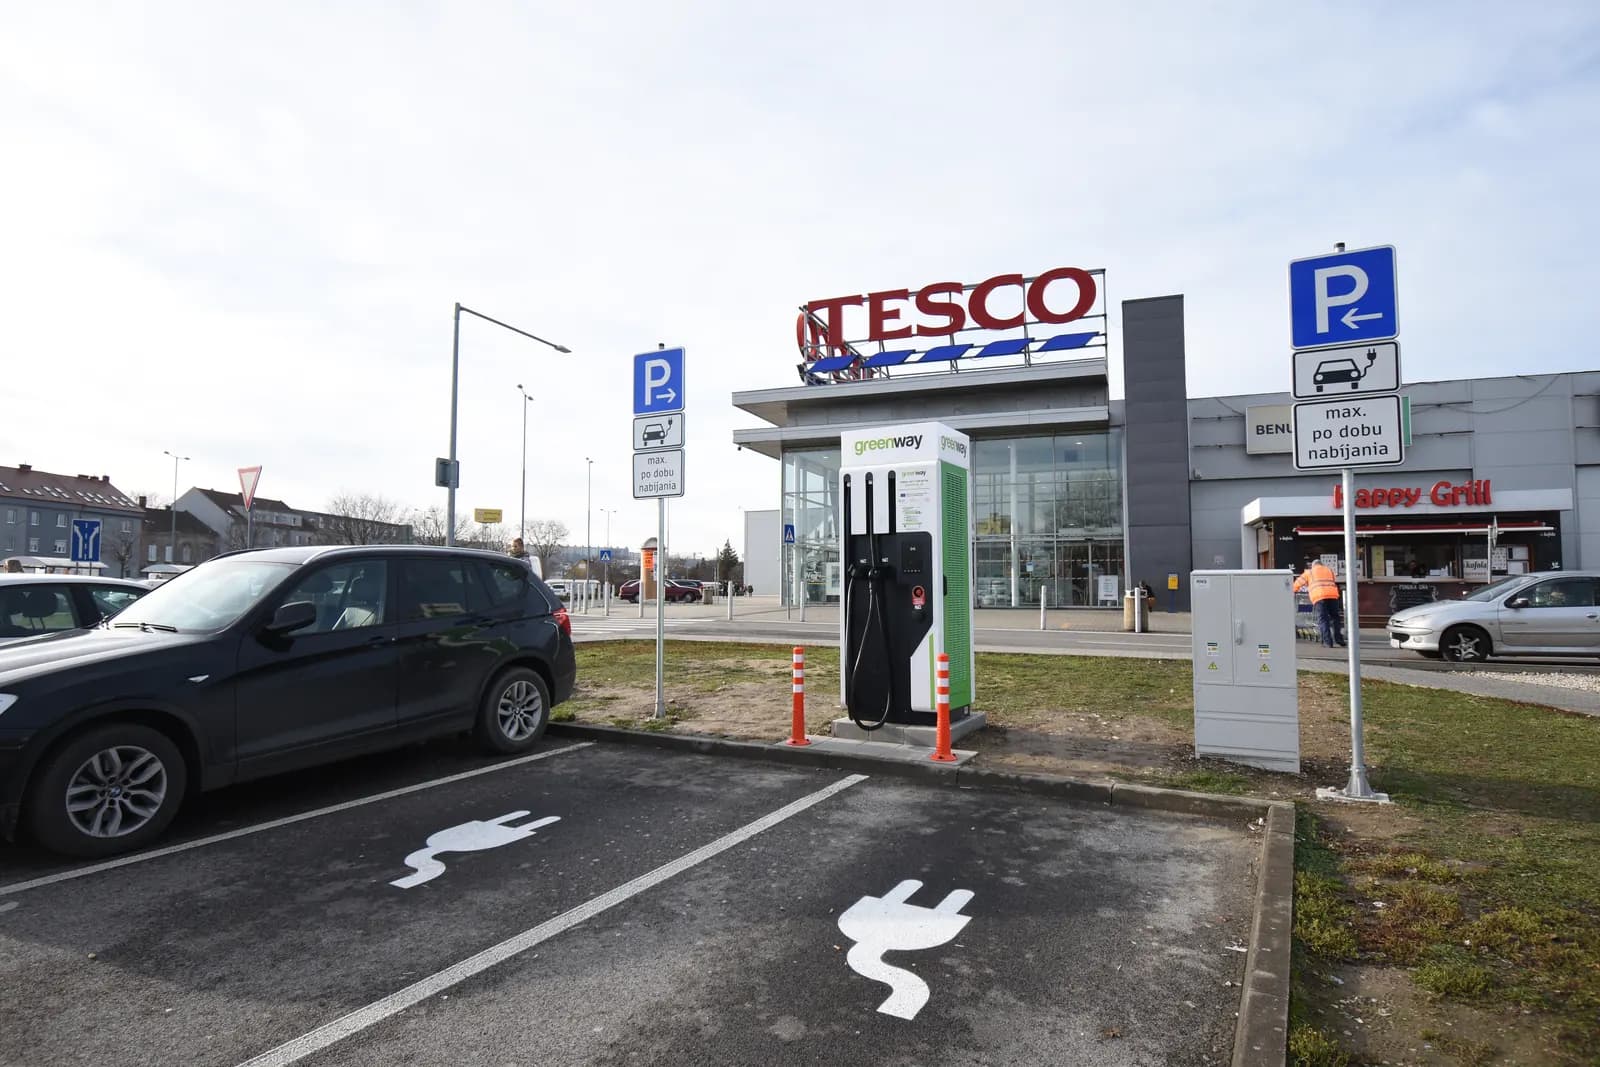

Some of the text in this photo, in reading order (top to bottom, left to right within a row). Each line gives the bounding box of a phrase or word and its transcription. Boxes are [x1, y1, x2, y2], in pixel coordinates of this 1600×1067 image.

[807, 267, 1096, 346] TESCO
[1314, 264, 1369, 334] P
[645, 358, 671, 406] P
[1326, 406, 1367, 420] max.
[1312, 423, 1382, 443] po dobu
[854, 434, 923, 456] greenway
[941, 435, 967, 458] greenway
[1308, 441, 1389, 461] nabíjania
[647, 456, 668, 465] max.
[641, 468, 674, 481] po dobu
[1430, 479, 1492, 507] Grill
